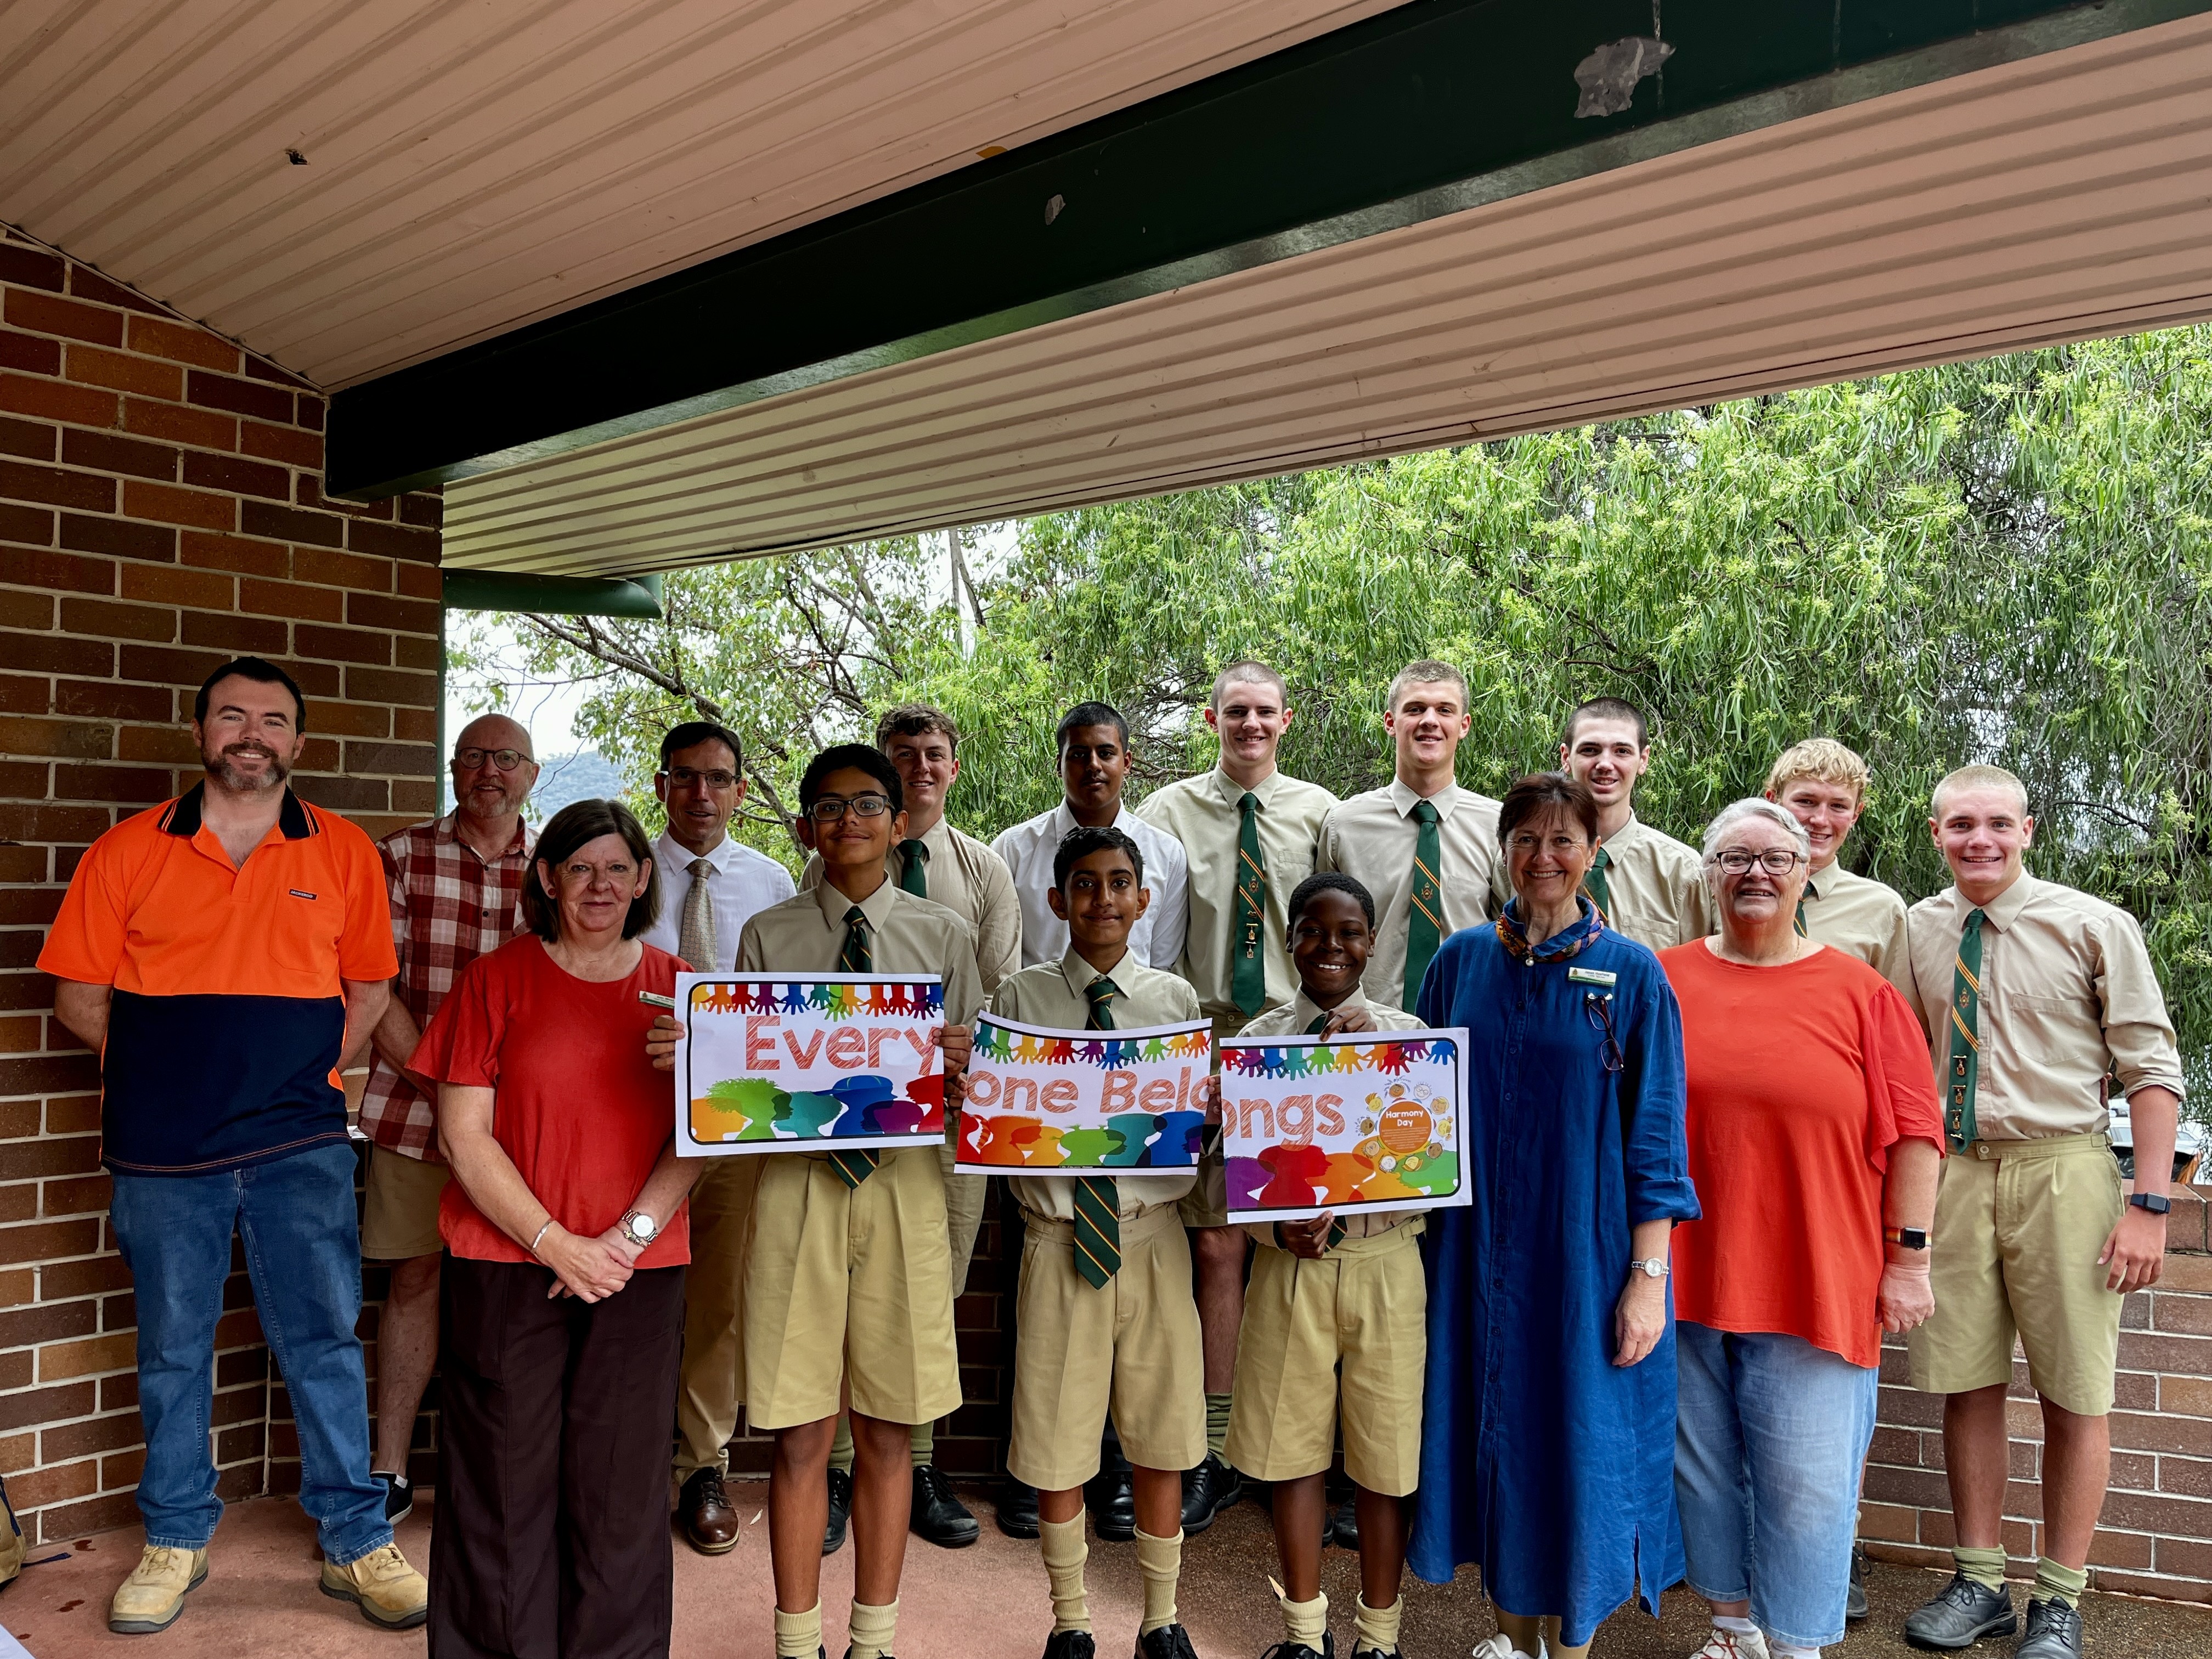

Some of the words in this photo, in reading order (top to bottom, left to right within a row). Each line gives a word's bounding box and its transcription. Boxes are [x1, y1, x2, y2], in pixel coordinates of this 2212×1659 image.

[746, 1015, 939, 1076] Every
[967, 1070, 1079, 1114] one
[1386, 1110, 1423, 1119] Harmony
